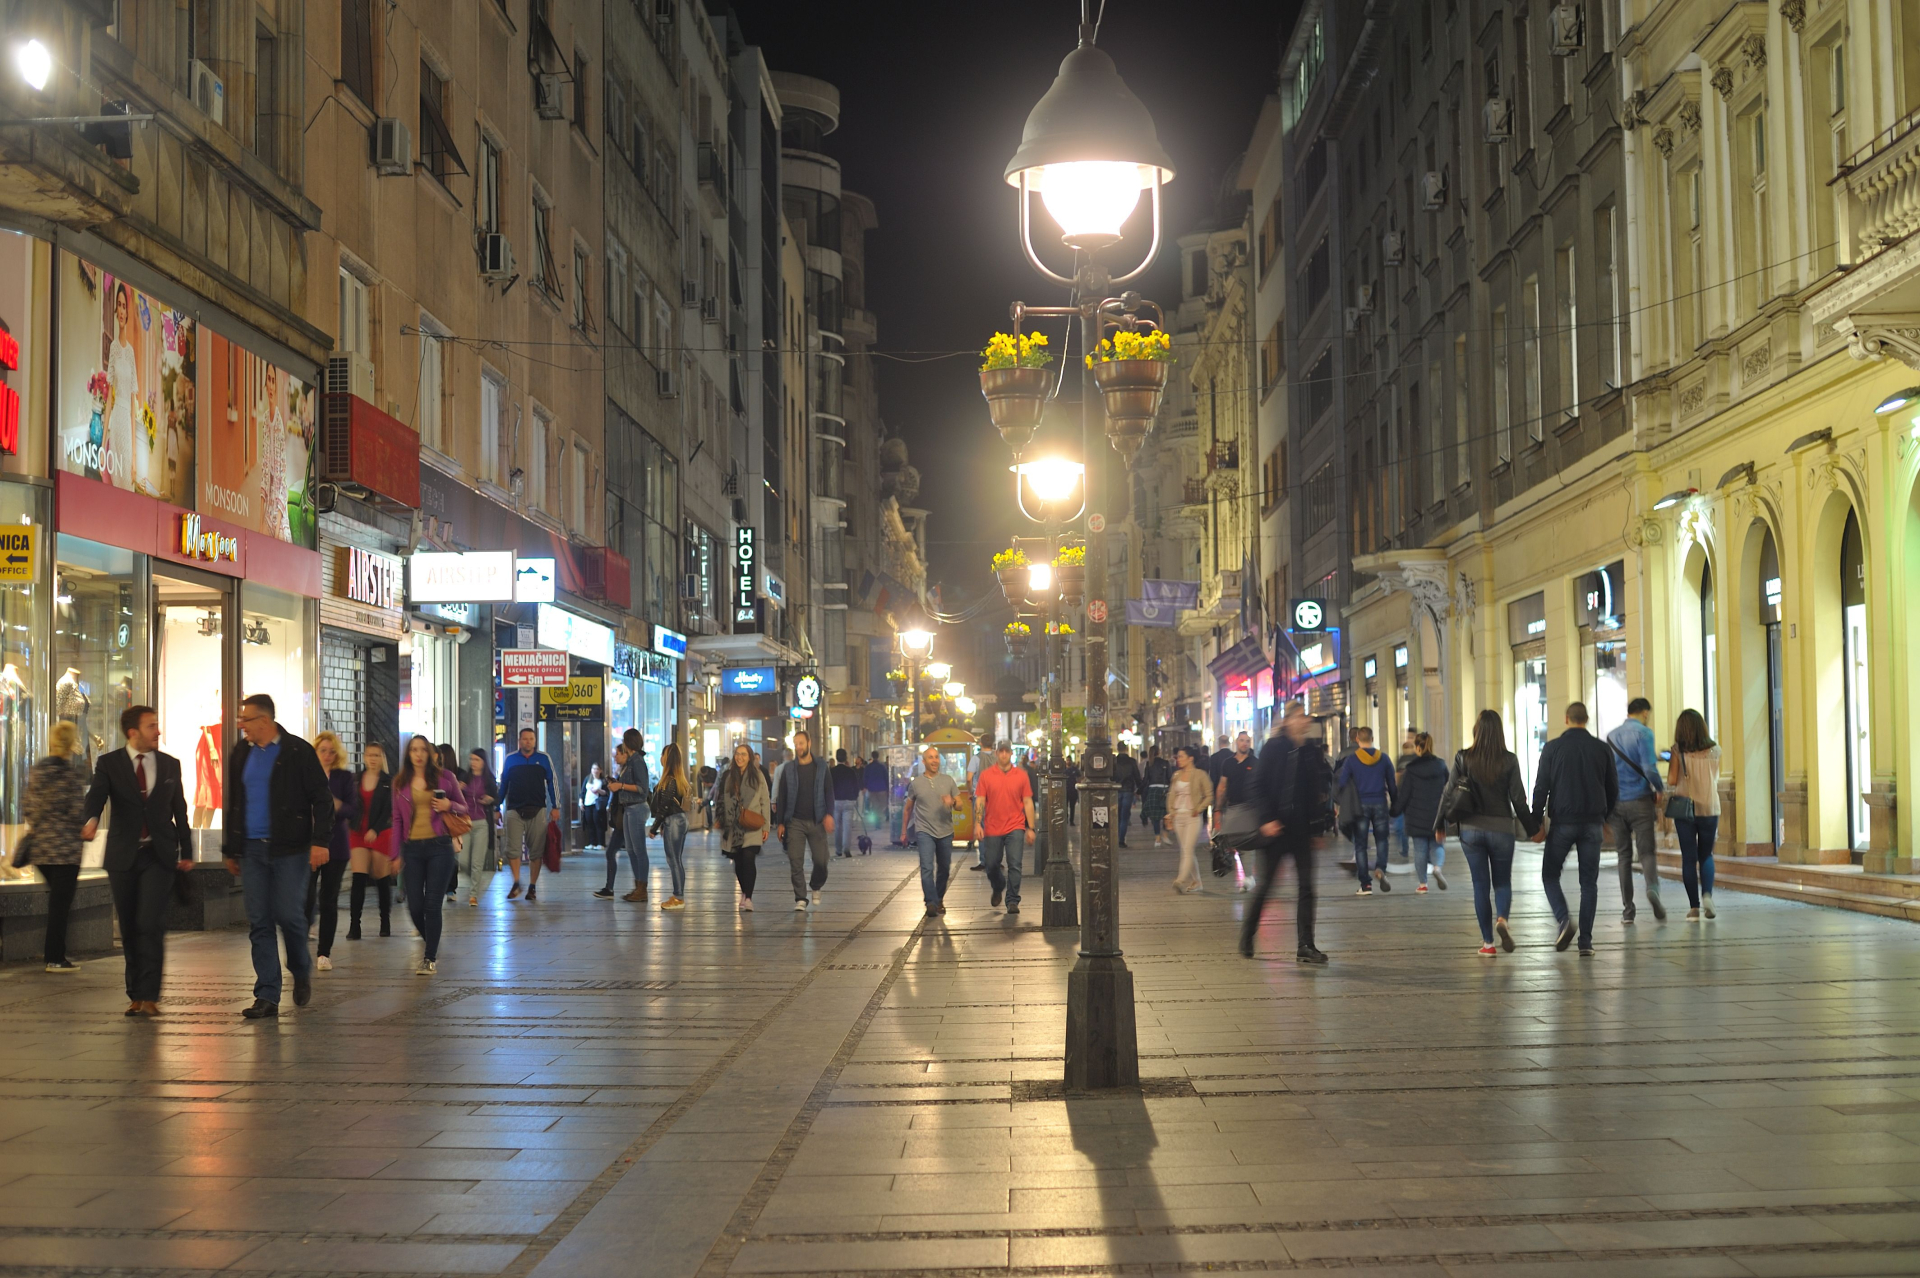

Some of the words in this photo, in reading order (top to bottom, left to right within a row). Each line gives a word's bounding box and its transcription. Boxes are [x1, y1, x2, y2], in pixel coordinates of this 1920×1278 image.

[63, 434, 123, 478] MONSOON
[205, 481, 249, 517] MONSOON
[182, 512, 238, 563] Monsoon
[0, 566, 28, 575] FFICE
[347, 545, 396, 610] AIRSTEP
[738, 528, 753, 606] HOTEL
[504, 652, 566, 667] MENJAČNICA
[527, 674, 543, 685] 5m
